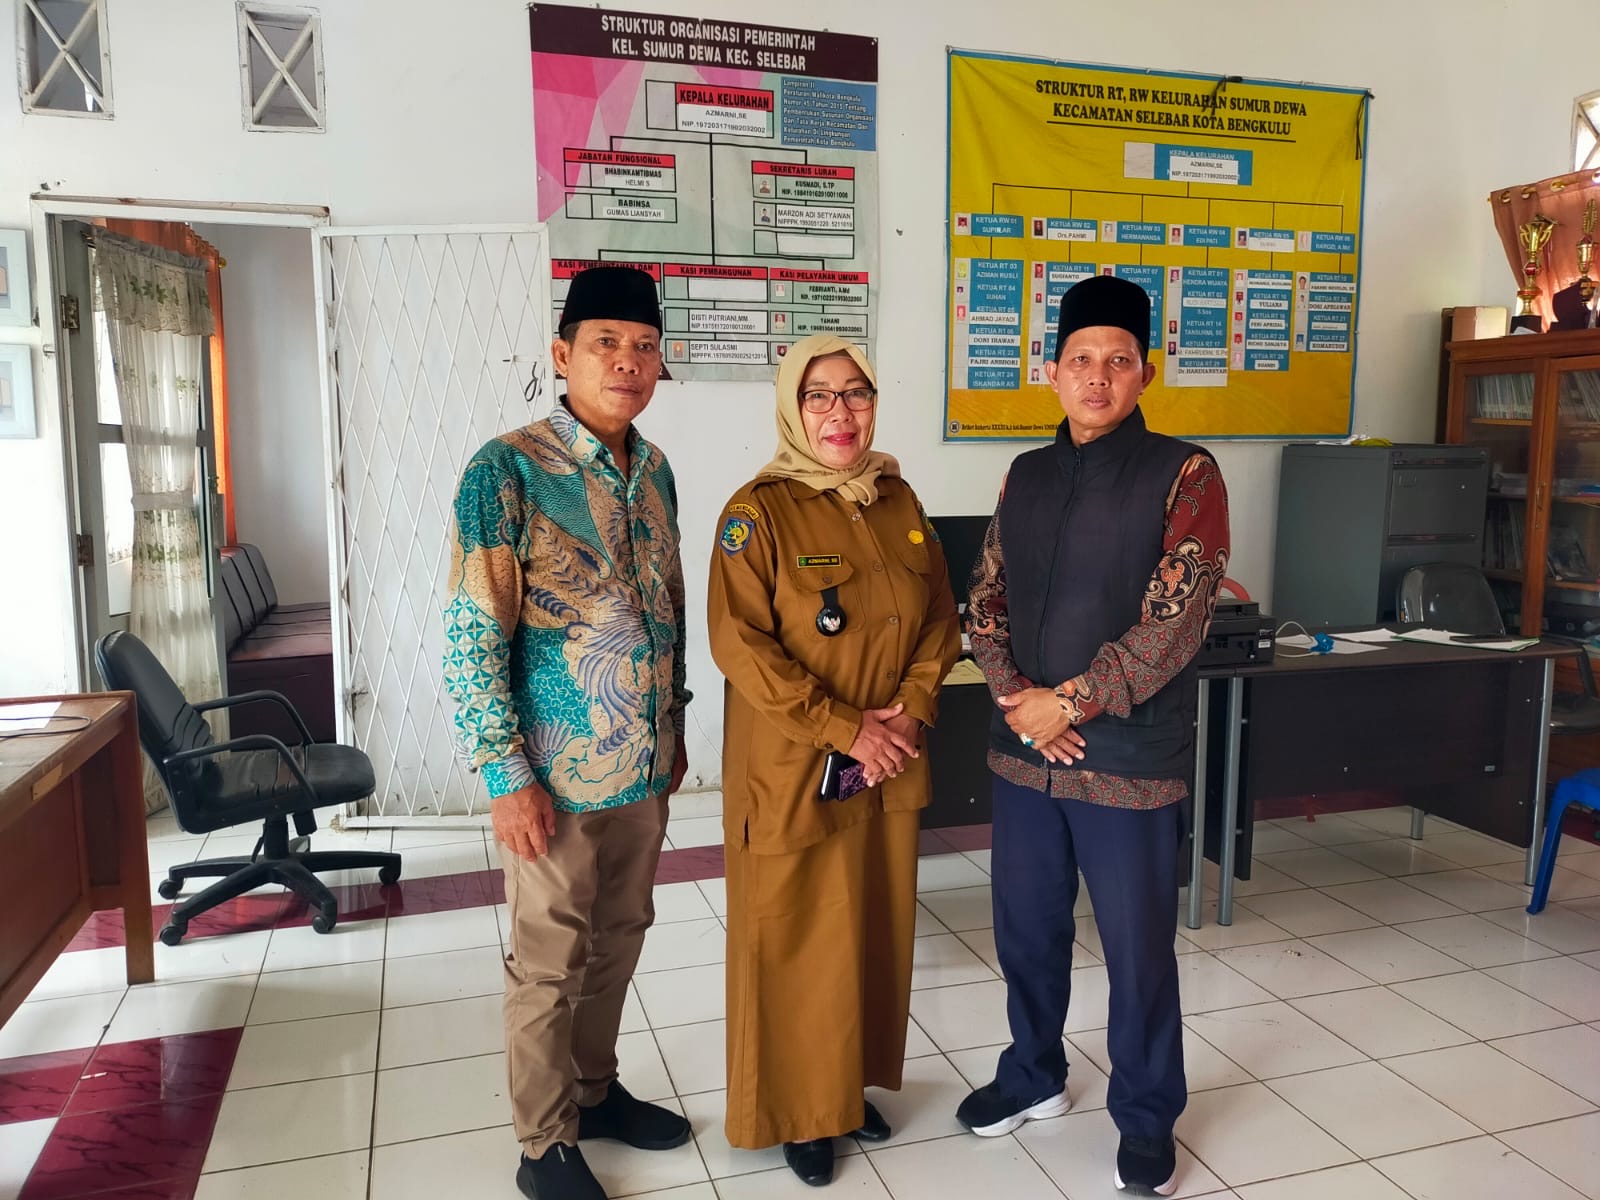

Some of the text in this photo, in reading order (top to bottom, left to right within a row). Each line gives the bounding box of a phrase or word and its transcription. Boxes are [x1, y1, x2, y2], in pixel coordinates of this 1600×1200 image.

[602, 14, 815, 51] STRUKTUR ORGANISASI PEMERINTAH
[612, 38, 806, 71] KEL. SUMUR DEWA KEC. SELEBAR
[680, 90, 769, 109] KEPALA KELURAHAN
[1036, 80, 1307, 116] STRUKTUR RT, RW KELURAHAN SUMUR DEWA
[1054, 102, 1291, 136] KECAMATAN SELEBAR KOTA BENGKULU
[578, 152, 661, 164] JABATAN FUNGSIONAL
[770, 165, 811, 175] SEKRETARIS
[618, 199, 650, 208] BABINSA
[699, 268, 752, 276] PEMBANGUNAN
[797, 272, 835, 280] PELAYANAN
